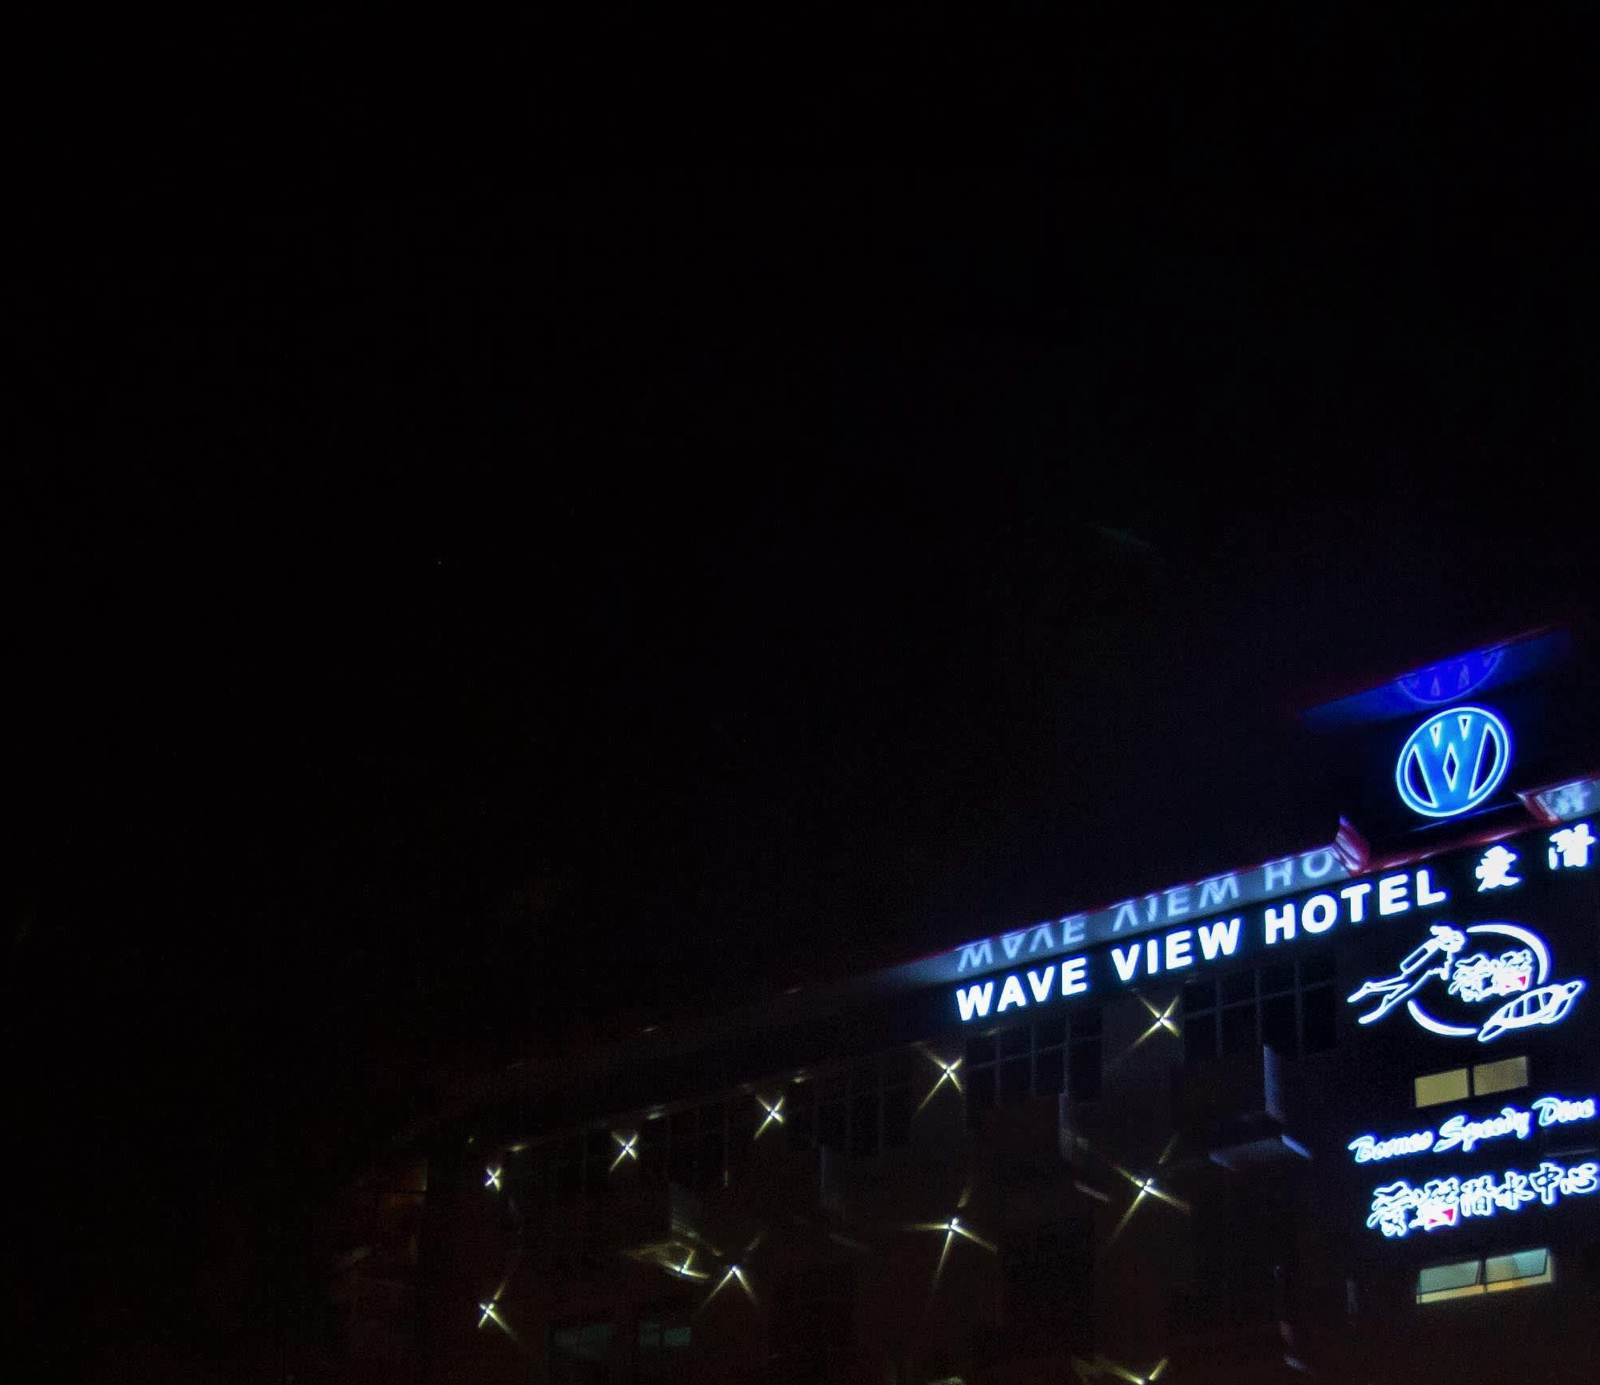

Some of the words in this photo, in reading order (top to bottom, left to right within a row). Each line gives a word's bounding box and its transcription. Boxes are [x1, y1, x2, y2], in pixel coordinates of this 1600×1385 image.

[956, 957, 1088, 1021] WAVE
[1111, 918, 1240, 981] VIEW
[1264, 869, 1447, 945] HOTEL
[1432, 1107, 1530, 1152] Speedy
